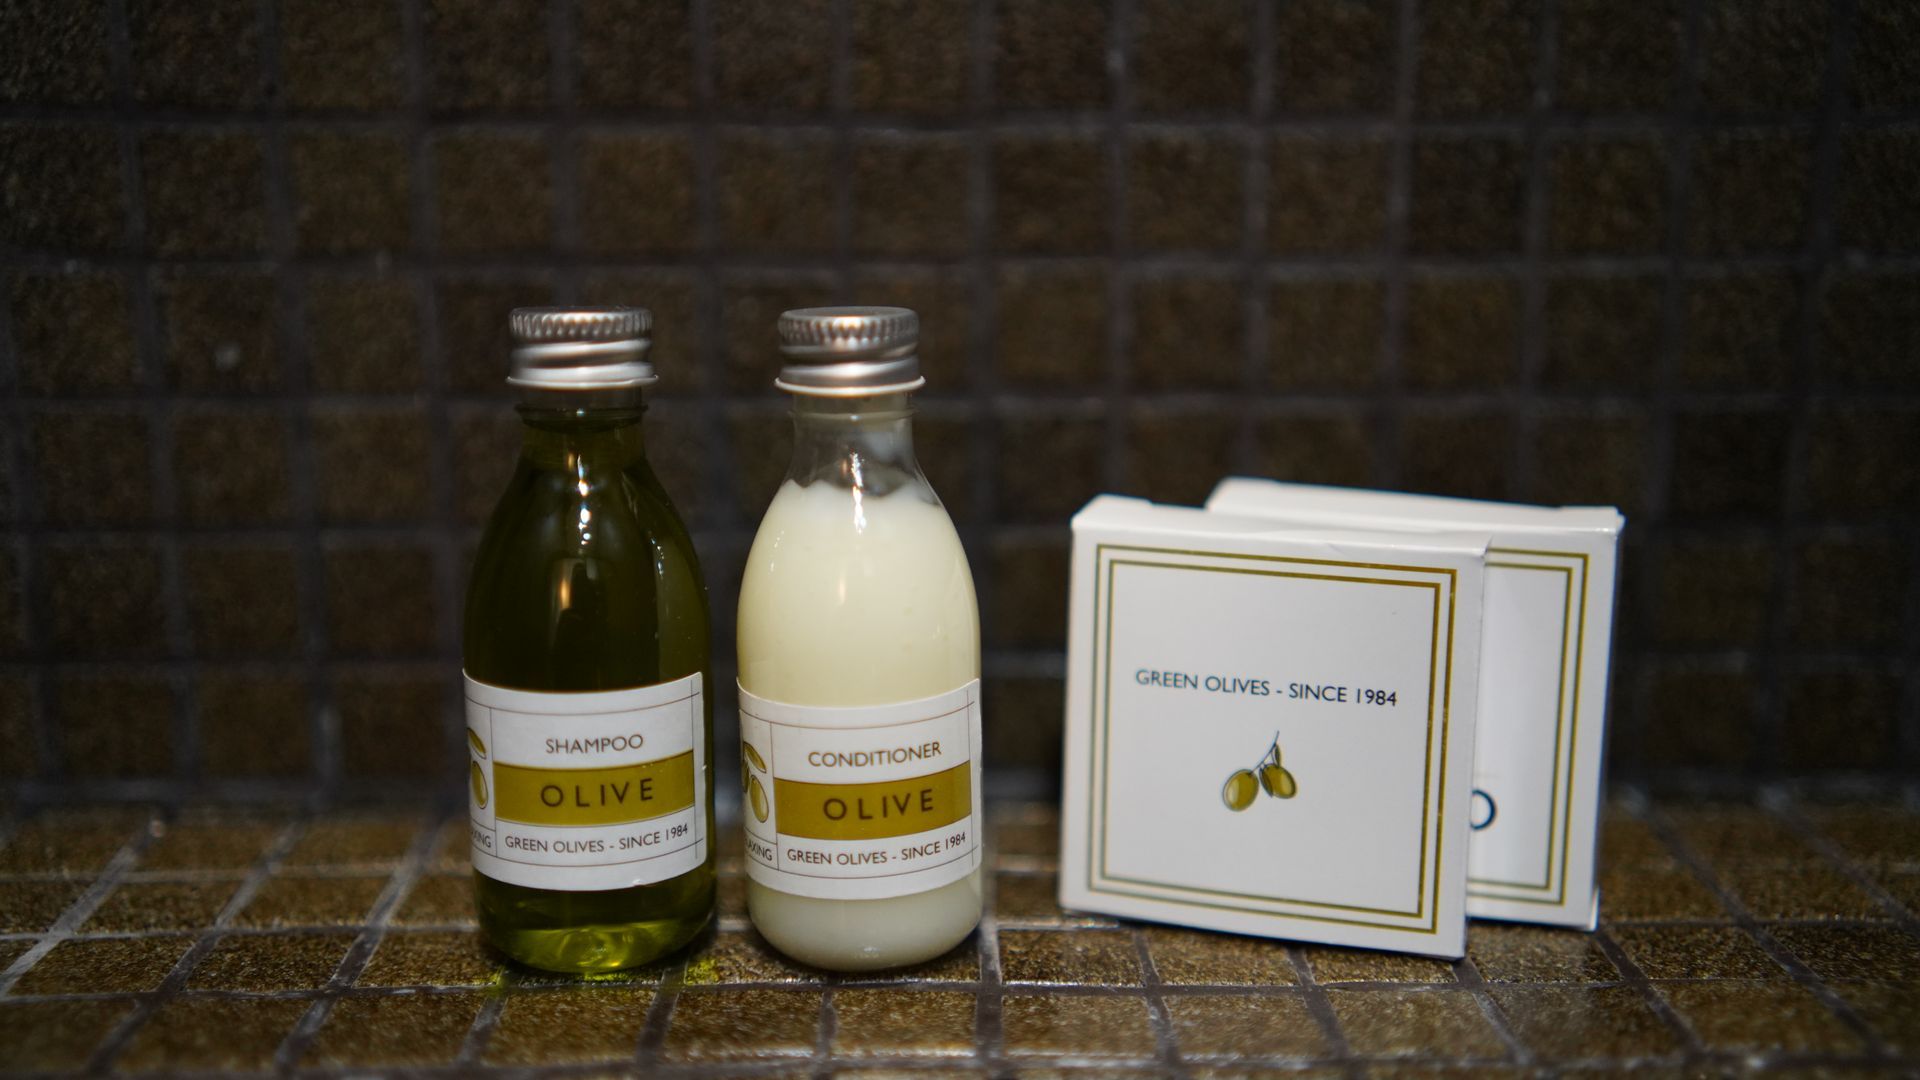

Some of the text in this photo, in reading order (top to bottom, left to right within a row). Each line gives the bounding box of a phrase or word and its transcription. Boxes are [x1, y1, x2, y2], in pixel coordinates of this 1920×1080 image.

[1135, 669, 1198, 690] GREEN
[1204, 675, 1270, 697] OLIVES
[1288, 683, 1347, 703] SINCE
[1356, 688, 1398, 707] 1984
[545, 734, 644, 754] SHAMPOO
[807, 741, 942, 768] CONDITIONER
[541, 778, 653, 807] OLIVE
[823, 789, 933, 820] OLIVE
[504, 835, 548, 853] GREEN
[553, 841, 605, 854] OLIVES
[619, 831, 661, 851] SINCE
[665, 823, 688, 842] 1984
[786, 848, 832, 866] GREEN
[836, 851, 888, 867] OLIVES
[901, 841, 941, 862] SINCE
[945, 832, 967, 851] 1984
